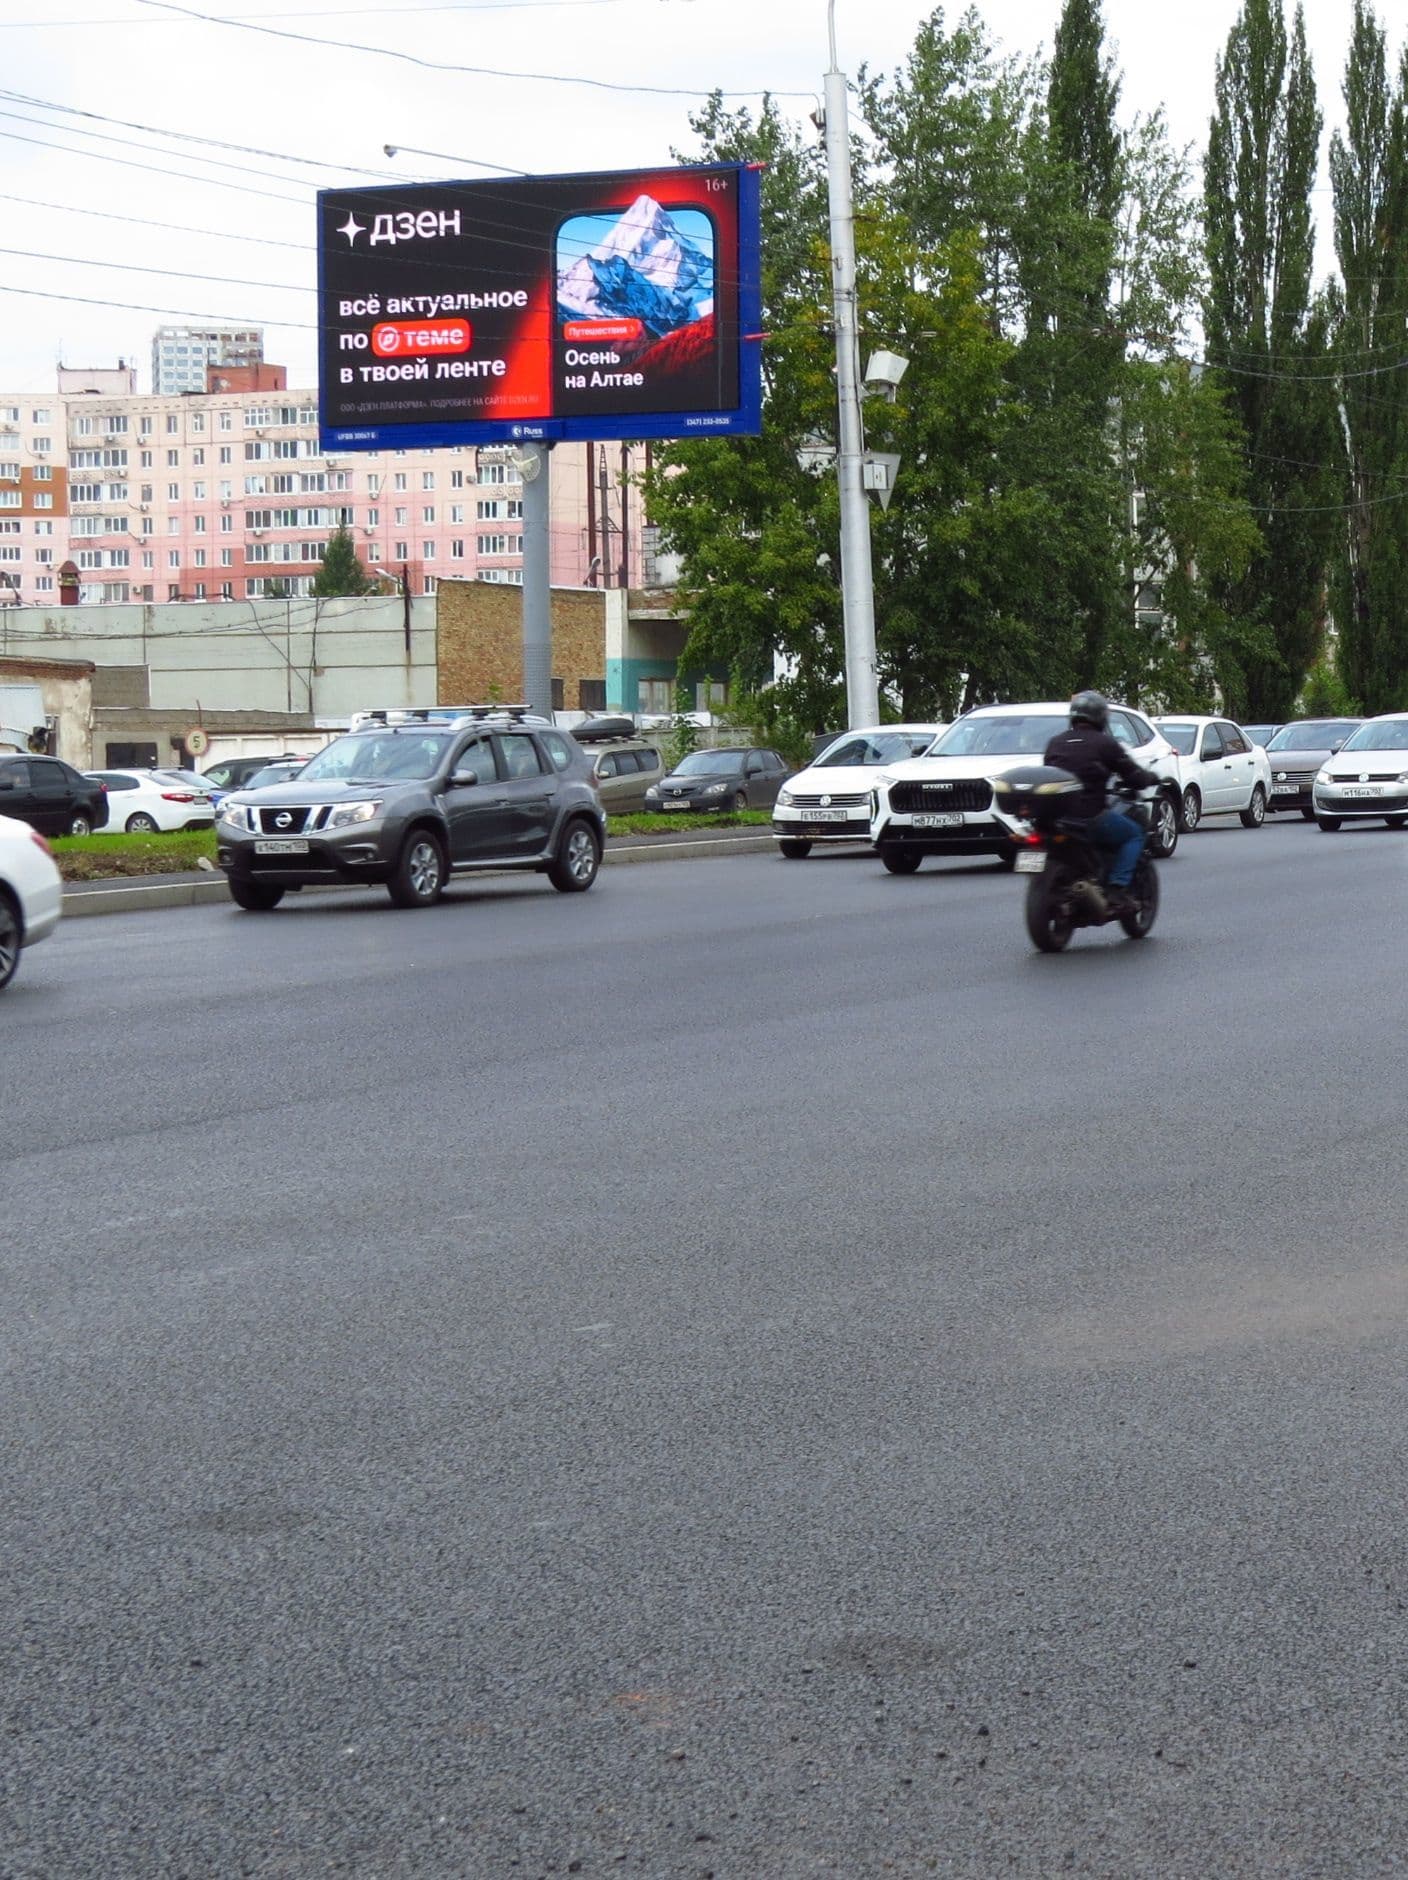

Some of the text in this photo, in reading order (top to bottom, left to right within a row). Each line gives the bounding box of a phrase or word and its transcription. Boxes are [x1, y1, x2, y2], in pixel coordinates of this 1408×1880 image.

[705, 178, 728, 192] 16+
[339, 289, 528, 318] всё актуальное
[339, 328, 464, 350] по теме
[568, 326, 627, 337] Путешествия
[565, 349, 621, 366] Осень
[340, 358, 506, 384] в твоей ленте
[565, 371, 644, 389] на Алтае
[193, 735, 201, 749] 5
